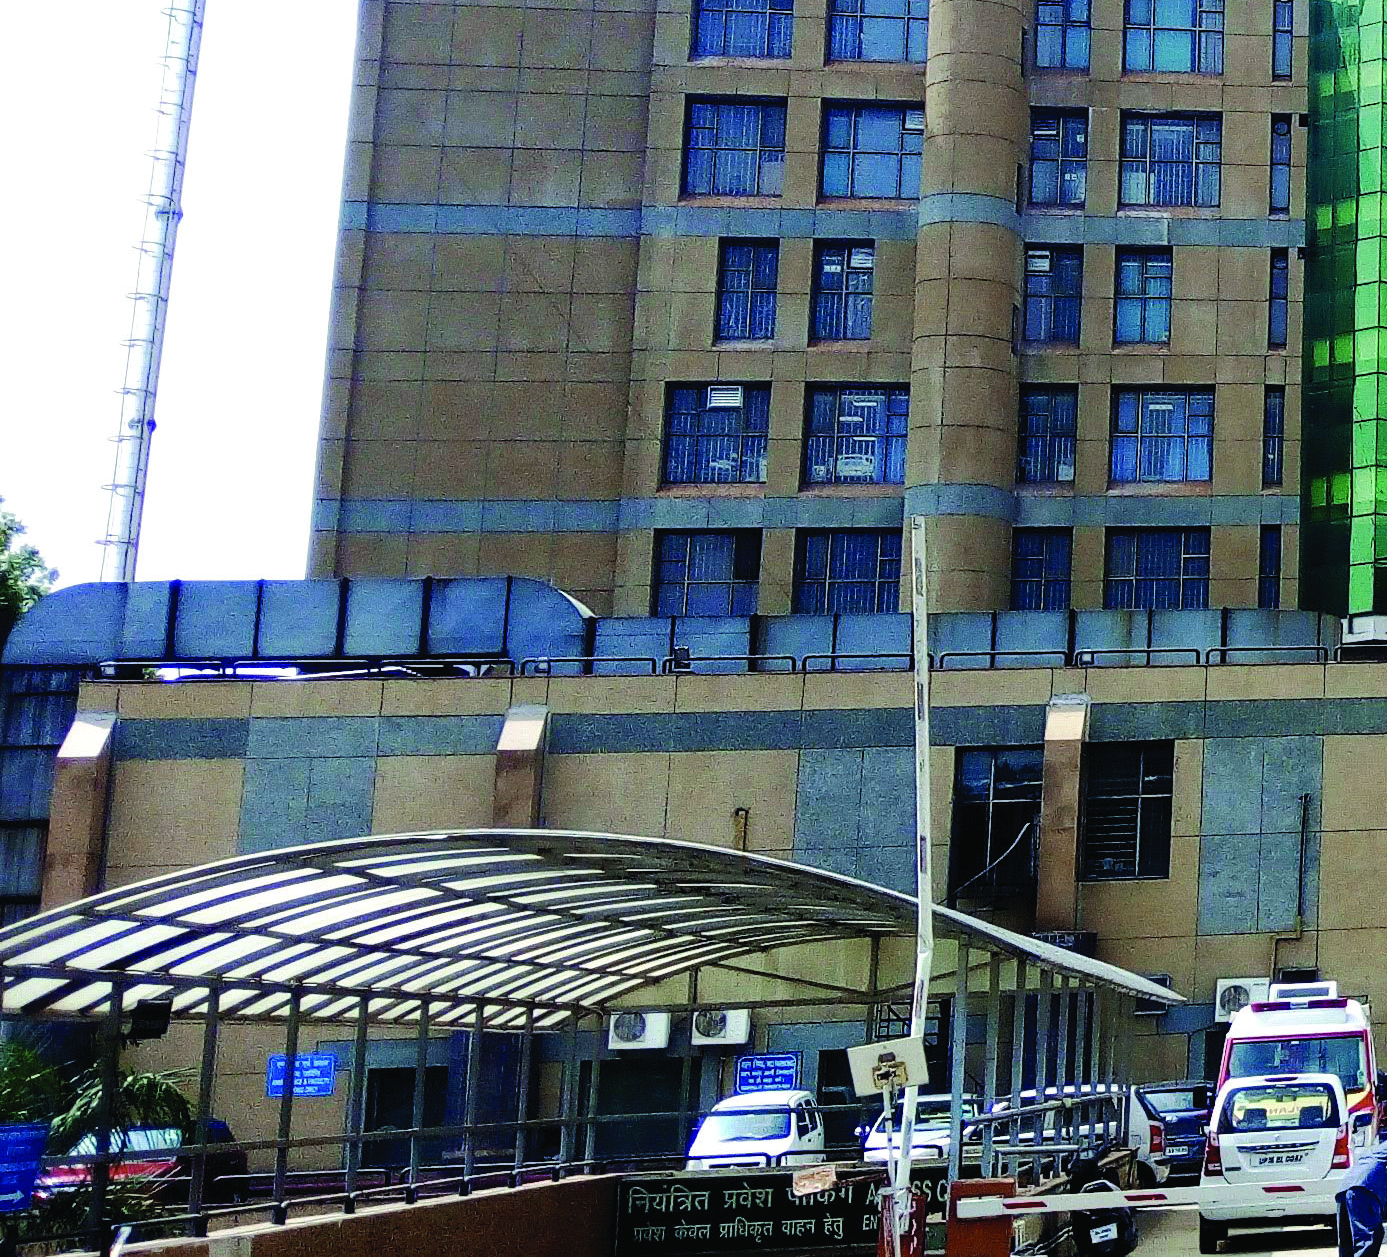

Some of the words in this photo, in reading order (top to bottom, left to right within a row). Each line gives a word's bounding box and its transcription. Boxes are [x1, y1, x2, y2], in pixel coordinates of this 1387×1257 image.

[627, 1184, 710, 1214] नियंत्रित
[723, 1181, 774, 1209] प्रवेश
[674, 1219, 711, 1240] केवल
[719, 1216, 774, 1243] प्राधिकृत
[782, 1218, 816, 1237] वाहन
[823, 1213, 844, 1239] हेतु
